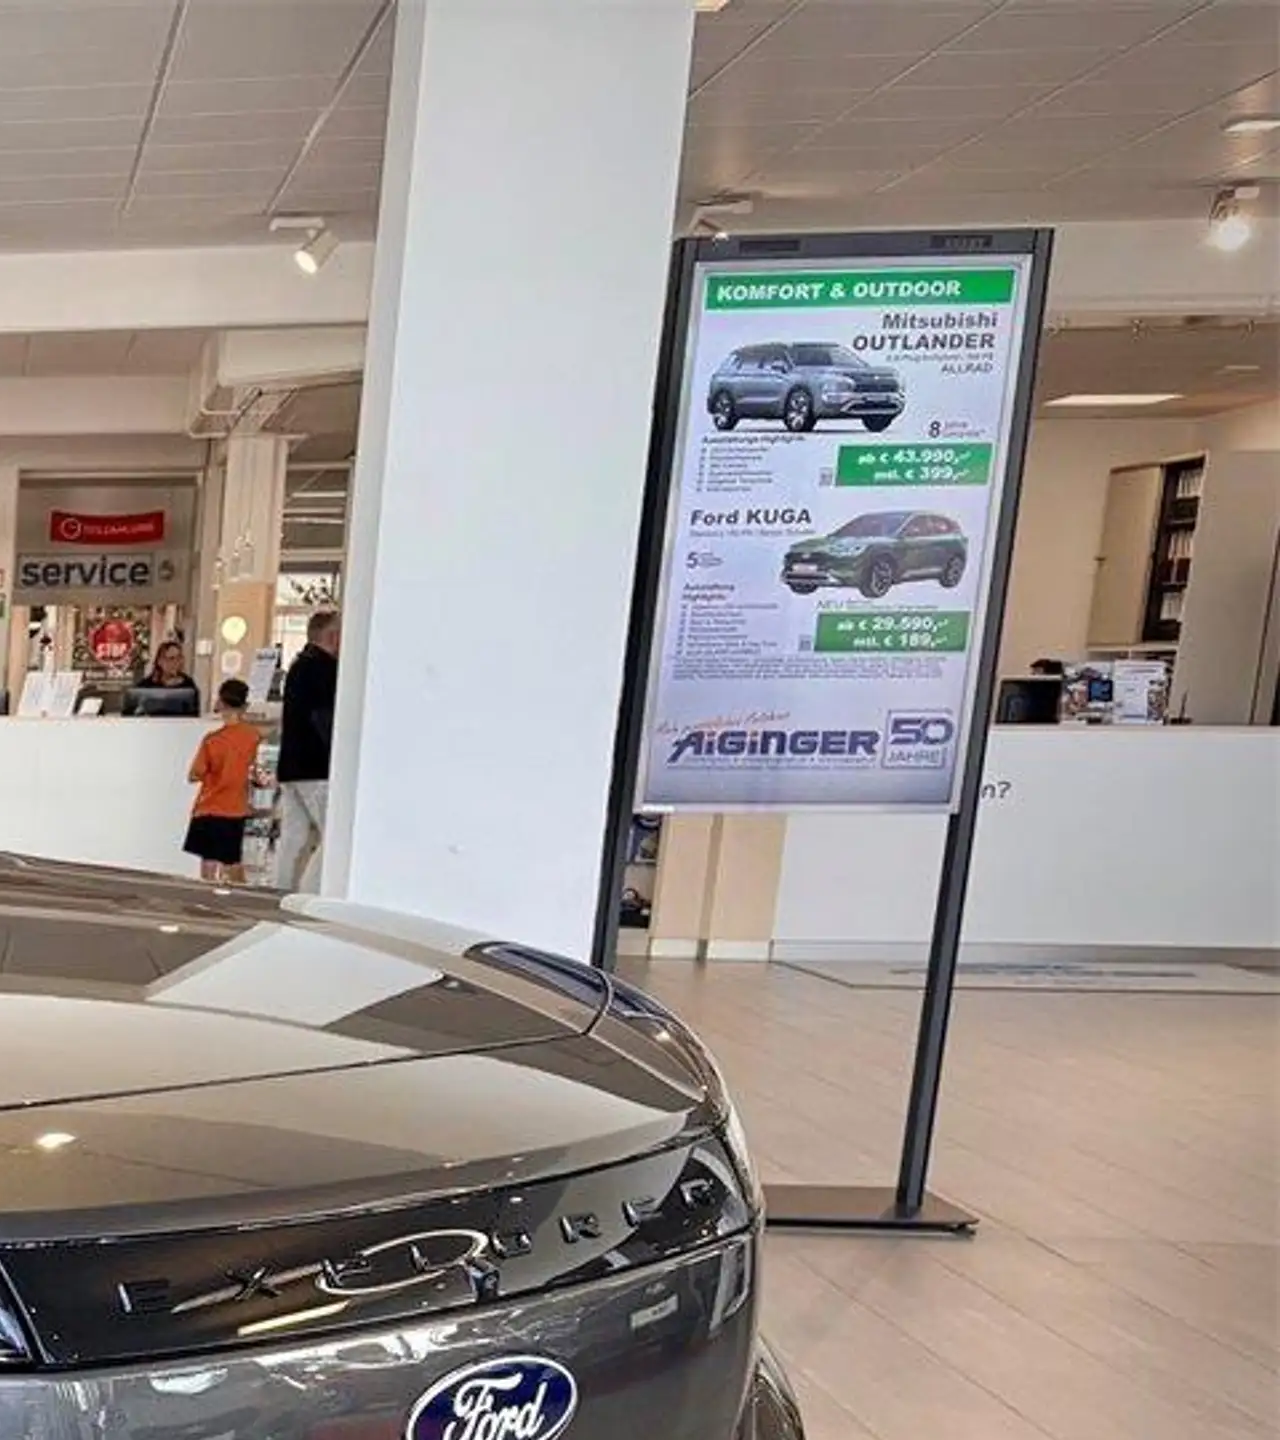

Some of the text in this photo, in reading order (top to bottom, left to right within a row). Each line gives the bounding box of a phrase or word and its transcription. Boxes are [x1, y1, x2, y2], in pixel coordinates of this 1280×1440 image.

[717, 280, 961, 302] KOMFORT & OUTDOOR
[882, 312, 998, 329] Mitsubishi
[853, 333, 996, 350] OUTLANDER
[929, 421, 941, 437] 8
[691, 508, 812, 526] Ford KUGA
[21, 555, 149, 586] service
[890, 717, 954, 745] 50
[888, 749, 939, 762] JAHRE
